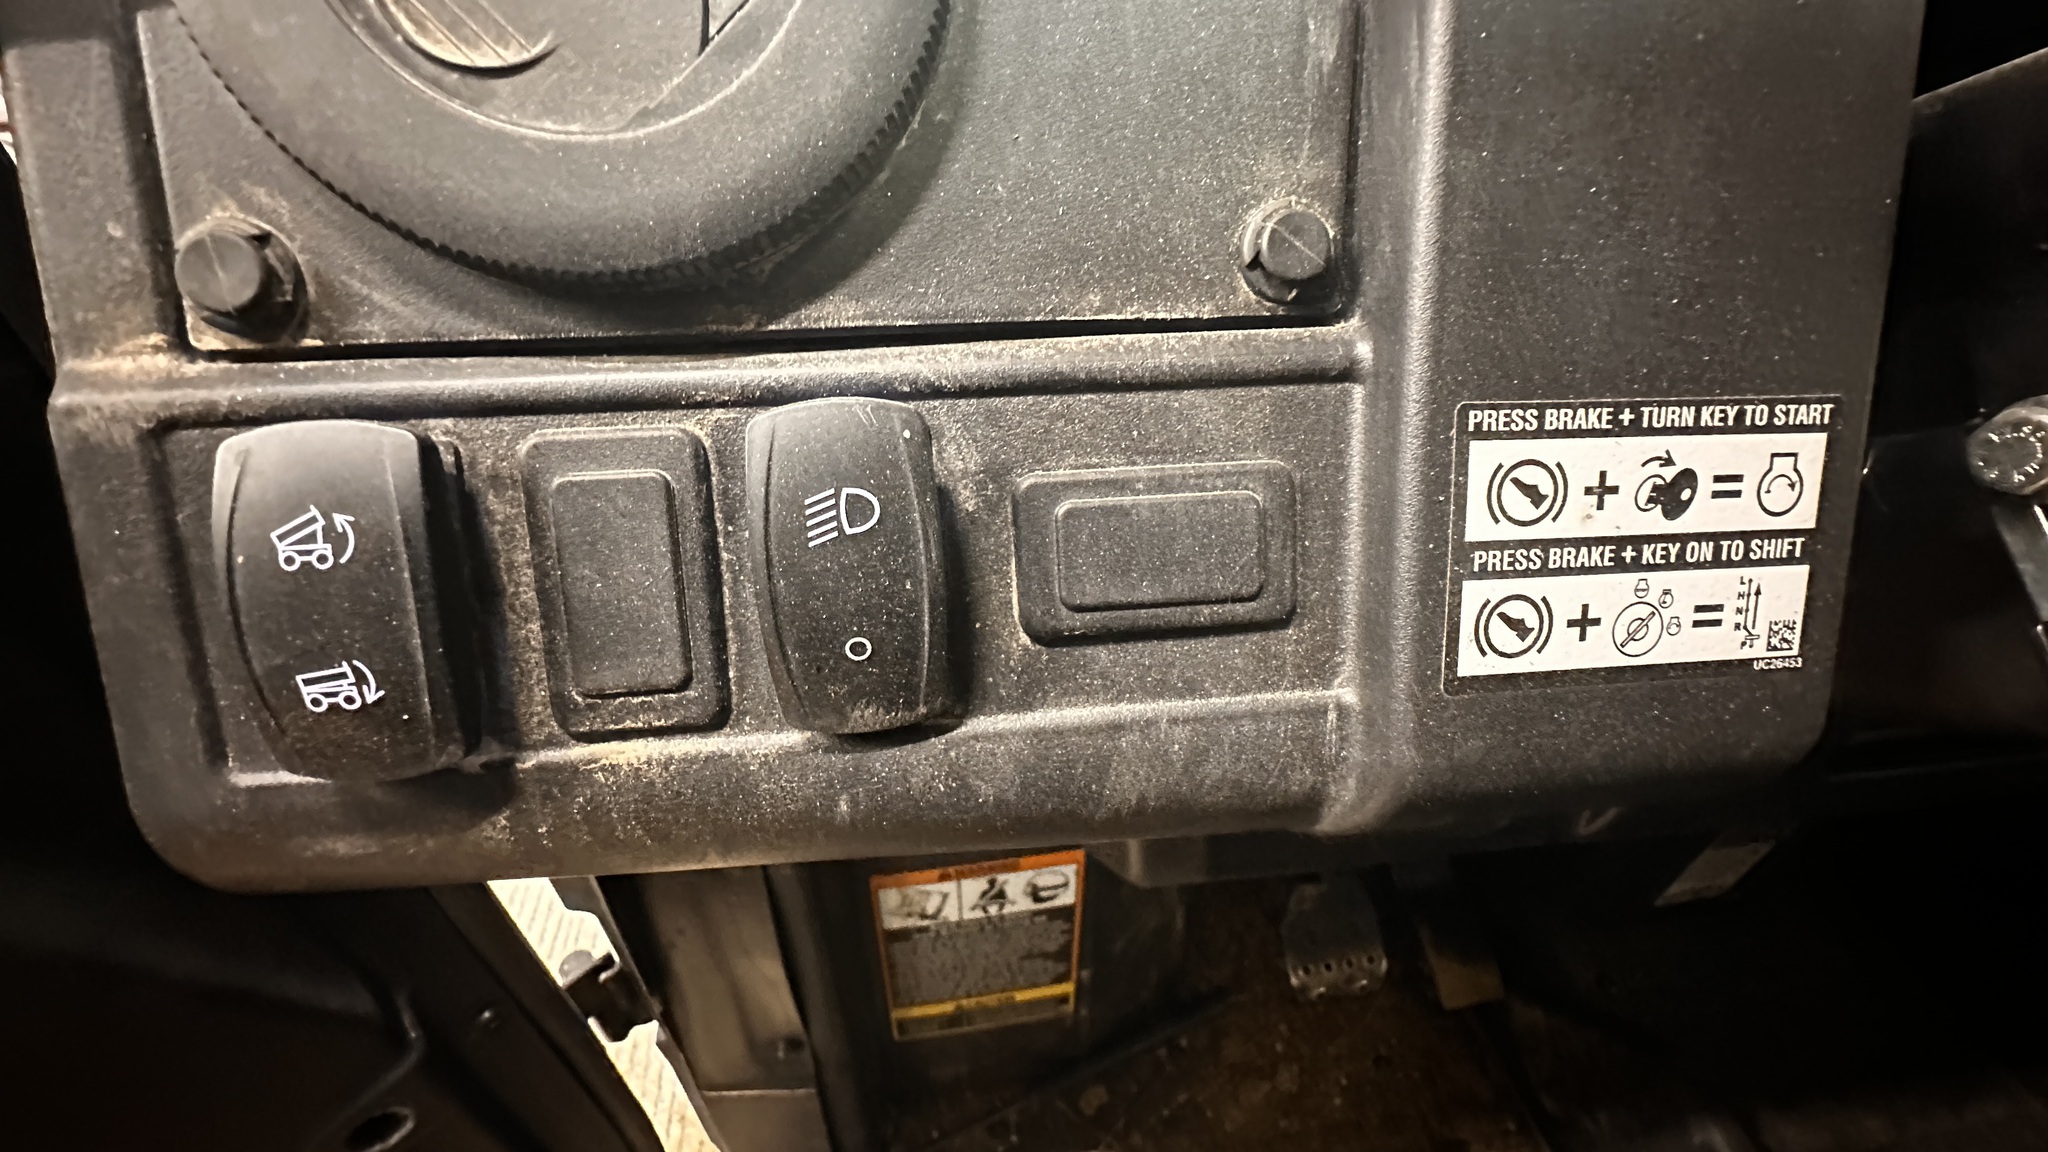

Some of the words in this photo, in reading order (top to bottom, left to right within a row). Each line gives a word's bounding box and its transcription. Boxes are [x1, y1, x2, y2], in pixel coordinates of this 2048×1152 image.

[1468, 408, 1538, 432] PRESS
[1544, 407, 1614, 430] BRAKE
[1618, 406, 1635, 426] +
[1641, 406, 1695, 428] TURN
[1700, 405, 1740, 427] KEY
[1744, 404, 1769, 426] TO
[1773, 403, 1834, 425] START
[1473, 549, 1542, 572] PRESS
[1548, 545, 1615, 568] BRAKE
[1620, 545, 1637, 564] +
[1641, 543, 1682, 564] KEY
[1686, 542, 1713, 563] ON
[1721, 540, 1745, 561] TO
[1748, 538, 1806, 560] SHIFT
[1740, 576, 1746, 585] L
[1736, 607, 1743, 615] N
[1734, 623, 1741, 631] R
[1740, 641, 1747, 650] P
[1753, 657, 1802, 670] UC26453
